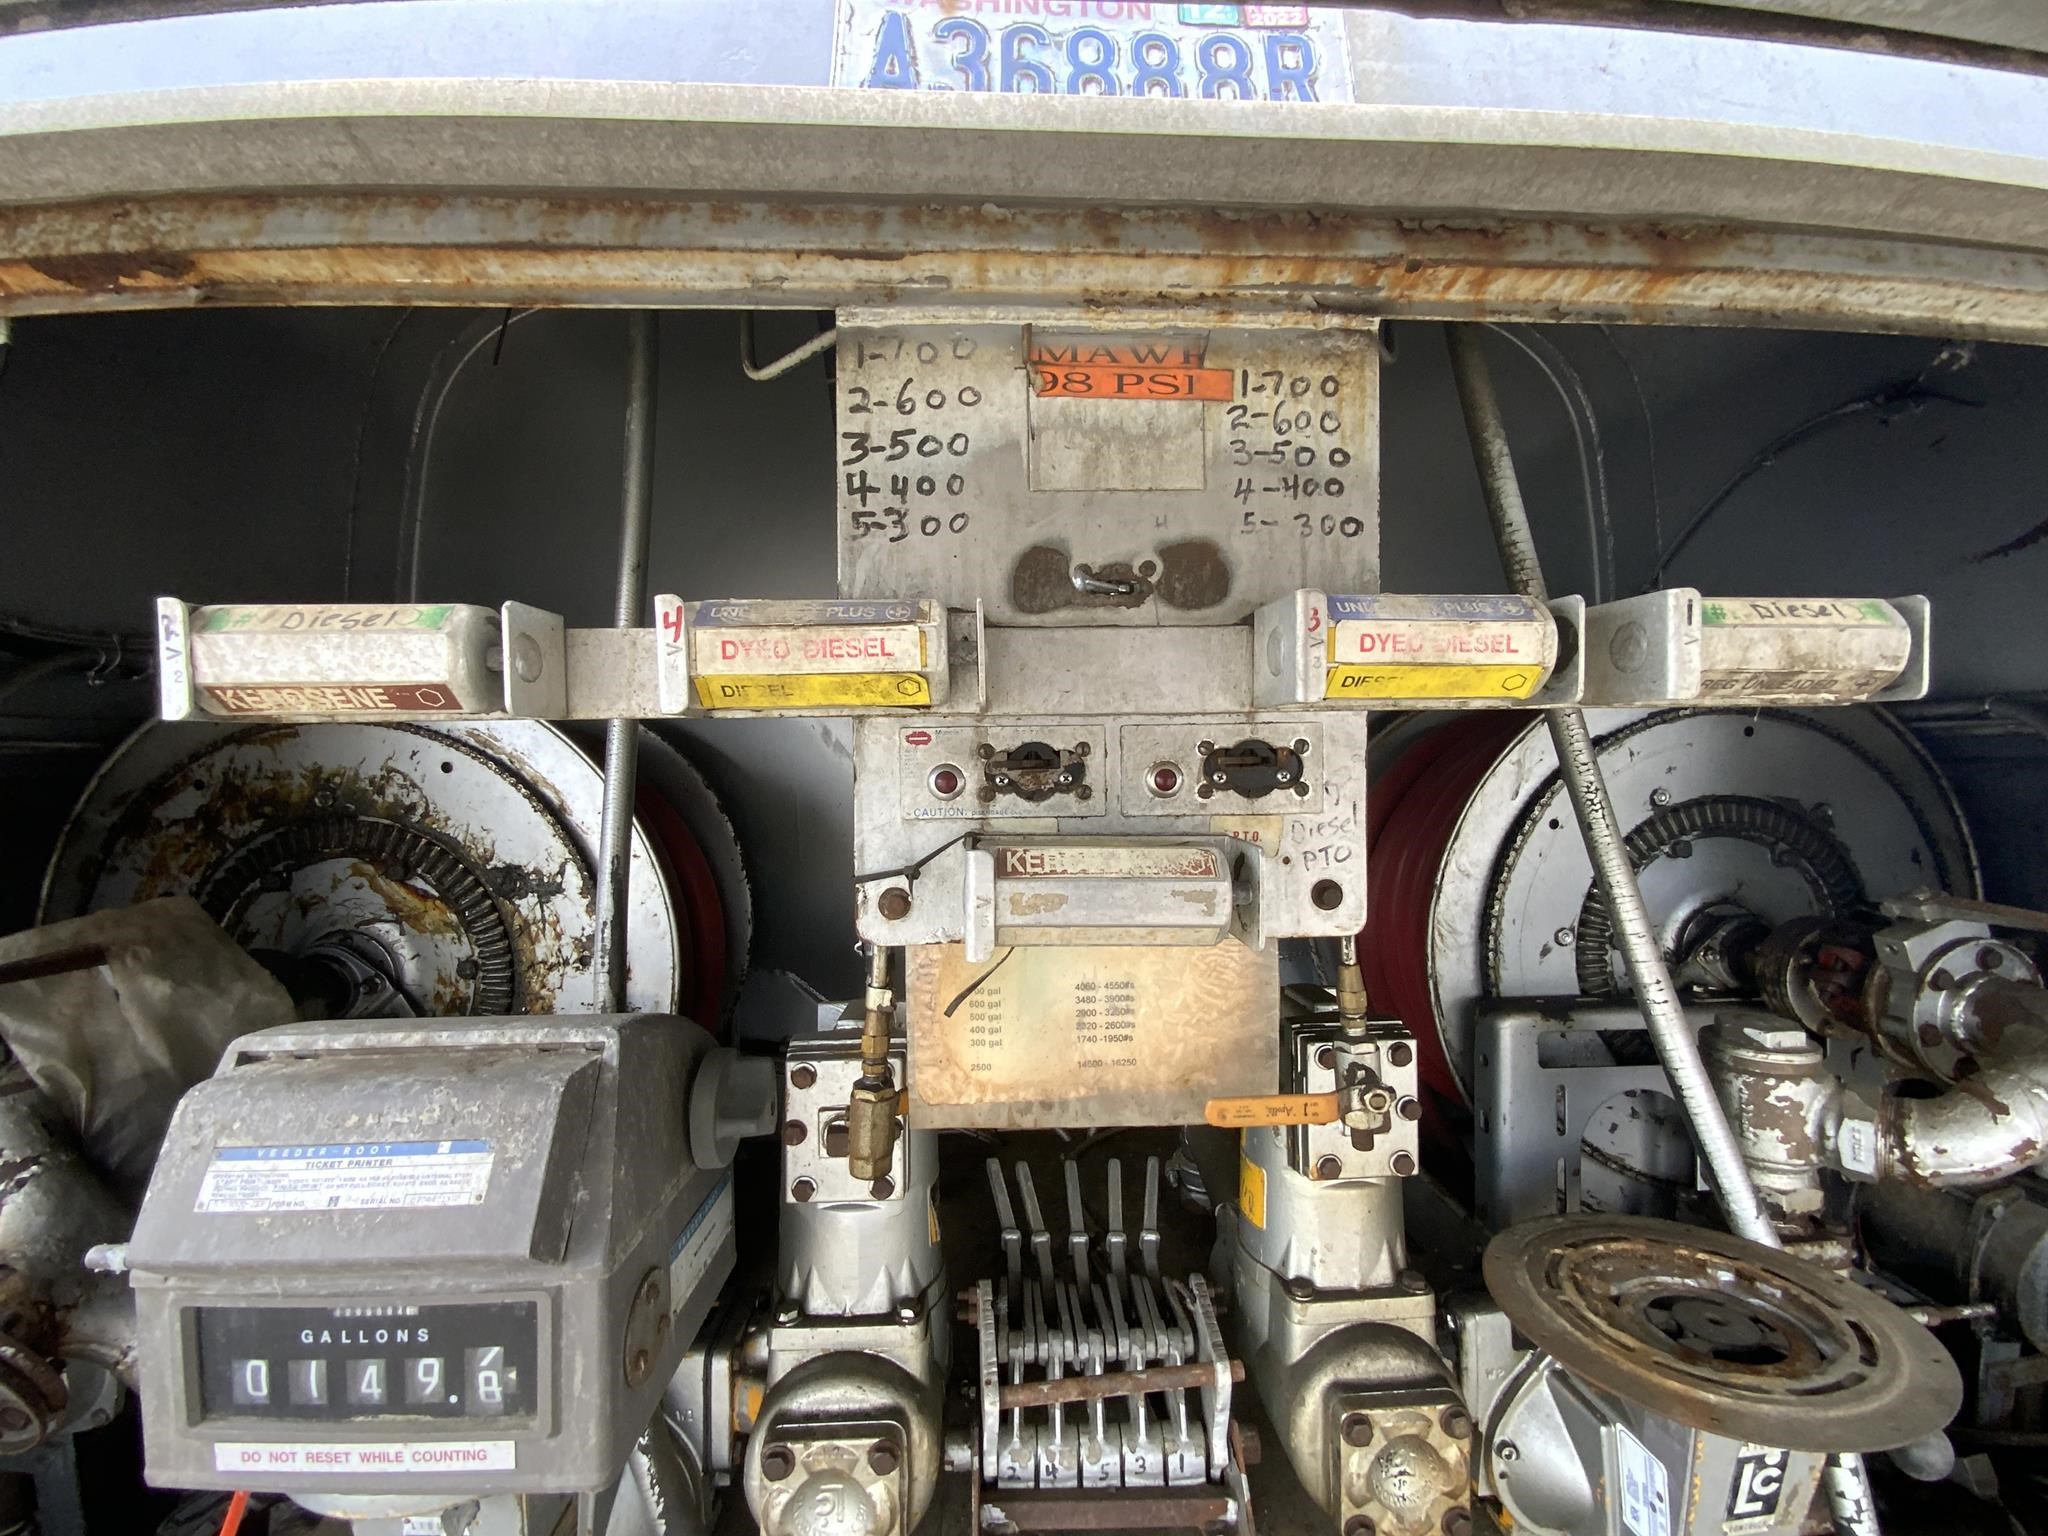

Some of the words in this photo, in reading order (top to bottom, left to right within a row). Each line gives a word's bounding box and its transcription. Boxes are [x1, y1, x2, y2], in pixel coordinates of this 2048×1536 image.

[869, 9, 1318, 102] A36888R
[1041, 371, 1093, 394] 98
[1113, 372, 1195, 395] PSI
[1241, 369, 1340, 397] 1-700
[847, 377, 982, 415] 2-600
[1226, 400, 1341, 436] 2-600
[841, 428, 969, 466] 3-500
[1229, 439, 1351, 467] 3-500
[845, 469, 965, 507] 4-400
[1233, 476, 1345, 505] 4-400
[850, 506, 969, 543] 5-300
[280, 609, 400, 630] Diesel
[825, 606, 876, 618] PLUS
[1750, 601, 1847, 620] Diesel
[663, 604, 684, 644] 4
[803, 637, 895, 660] DIESEL
[1431, 634, 1519, 653] IESEL
[1742, 679, 1839, 690] UNEADED
[213, 687, 397, 711] KEROSENE
[1302, 844, 1353, 872] PTO
[987, 987, 1001, 996] gal
[1074, 982, 1096, 991] 4060
[969, 1000, 985, 1008] 600
[987, 1000, 1001, 1009] gal
[1074, 995, 1096, 1004] 3480
[969, 1013, 985, 1021] 500
[988, 1013, 1002, 1022] gal
[970, 1026, 985, 1034] 400
[988, 1026, 1002, 1036] gal
[1077, 1034, 1098, 1043] 1740
[970, 1039, 986, 1047] 300
[988, 1038, 1002, 1048] gal
[970, 1063, 992, 1072] 2500
[305, 1160, 343, 1170] TICKET
[347, 1158, 393, 1169] PRINTER
[301, 1328, 430, 1344] GALLONS
[241, 1451, 262, 1464] DO
[269, 1451, 297, 1464] NOT
[305, 1450, 351, 1464] RESET
[360, 1450, 404, 1464] WHILE
[412, 1448, 488, 1463] COUNTING
[1007, 1465, 1022, 1481] 2
[1045, 1462, 1058, 1479] 4
[1099, 1463, 1111, 1481] 5
[1135, 1455, 1147, 1476] 3
